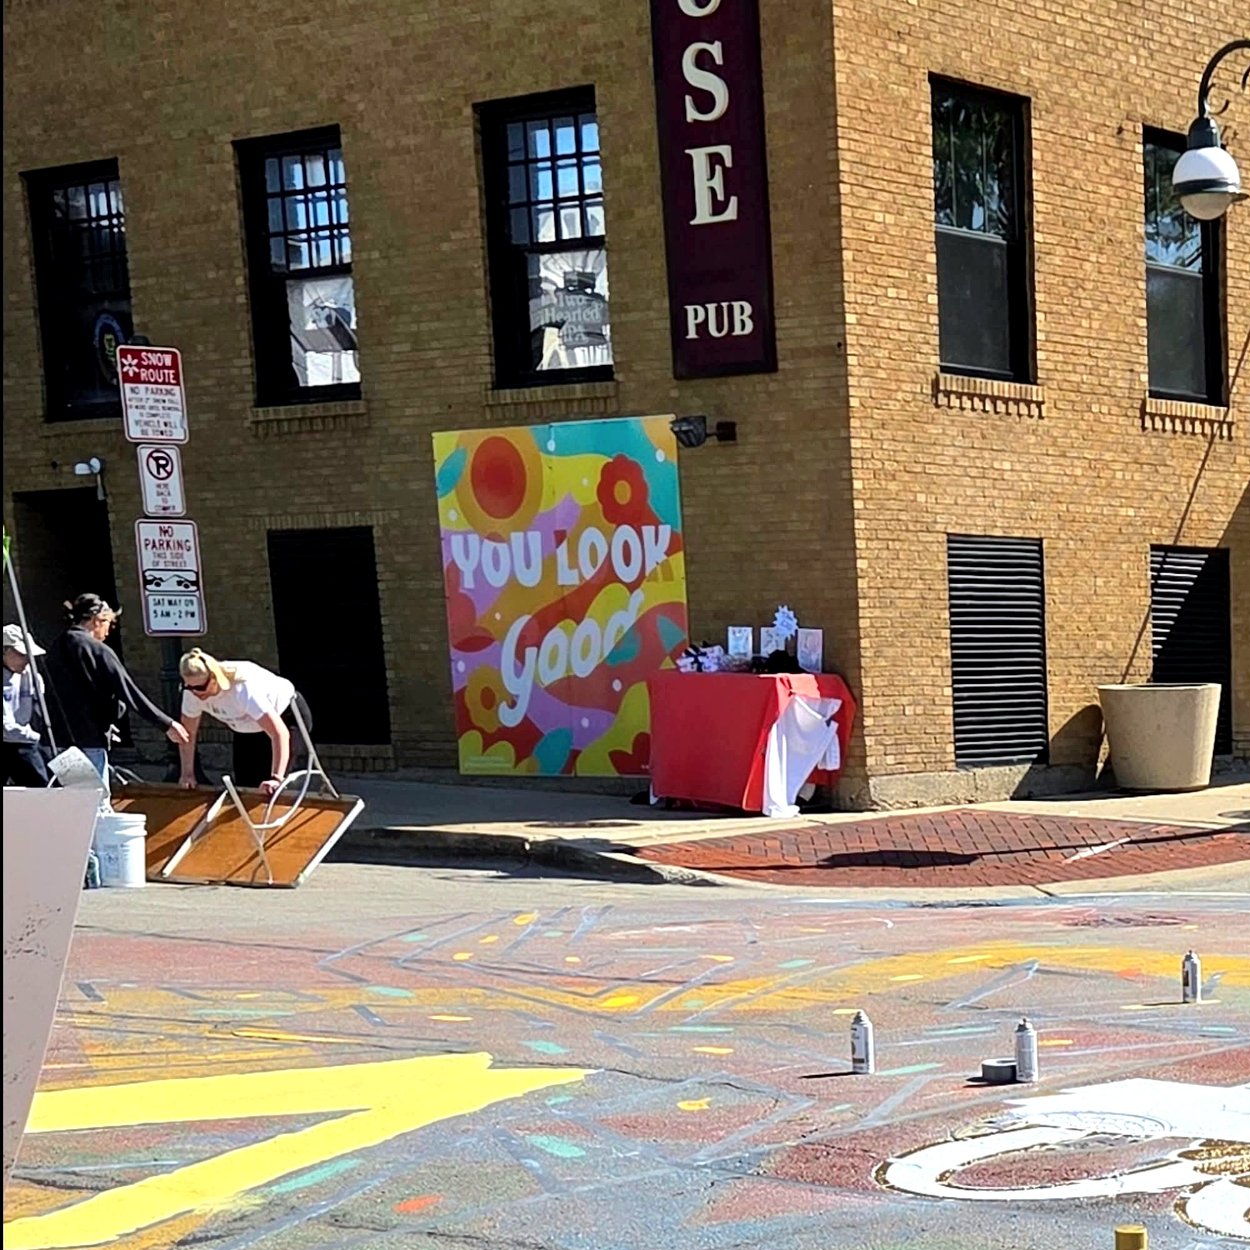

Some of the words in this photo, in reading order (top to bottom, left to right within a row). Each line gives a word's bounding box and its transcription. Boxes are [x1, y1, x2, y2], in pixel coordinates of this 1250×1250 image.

[676, 0, 739, 226] SE
[684, 300, 755, 339] PUB
[140, 351, 173, 367] SNOW
[140, 368, 177, 384] ROUTE
[130, 386, 139, 395] NO
[145, 387, 176, 396] PARKING
[158, 526, 174, 538] NO
[144, 538, 192, 552] PARKING
[153, 551, 169, 560] THIS
[170, 552, 185, 561] SIDE
[451, 530, 543, 590] YOU
[555, 523, 673, 586] LOOK
[152, 560, 161, 568] OF
[163, 560, 188, 568] STREET
[152, 598, 165, 607] SAT
[167, 598, 182, 607] MAY
[160, 610, 171, 618] AM
[185, 611, 196, 619] PM
